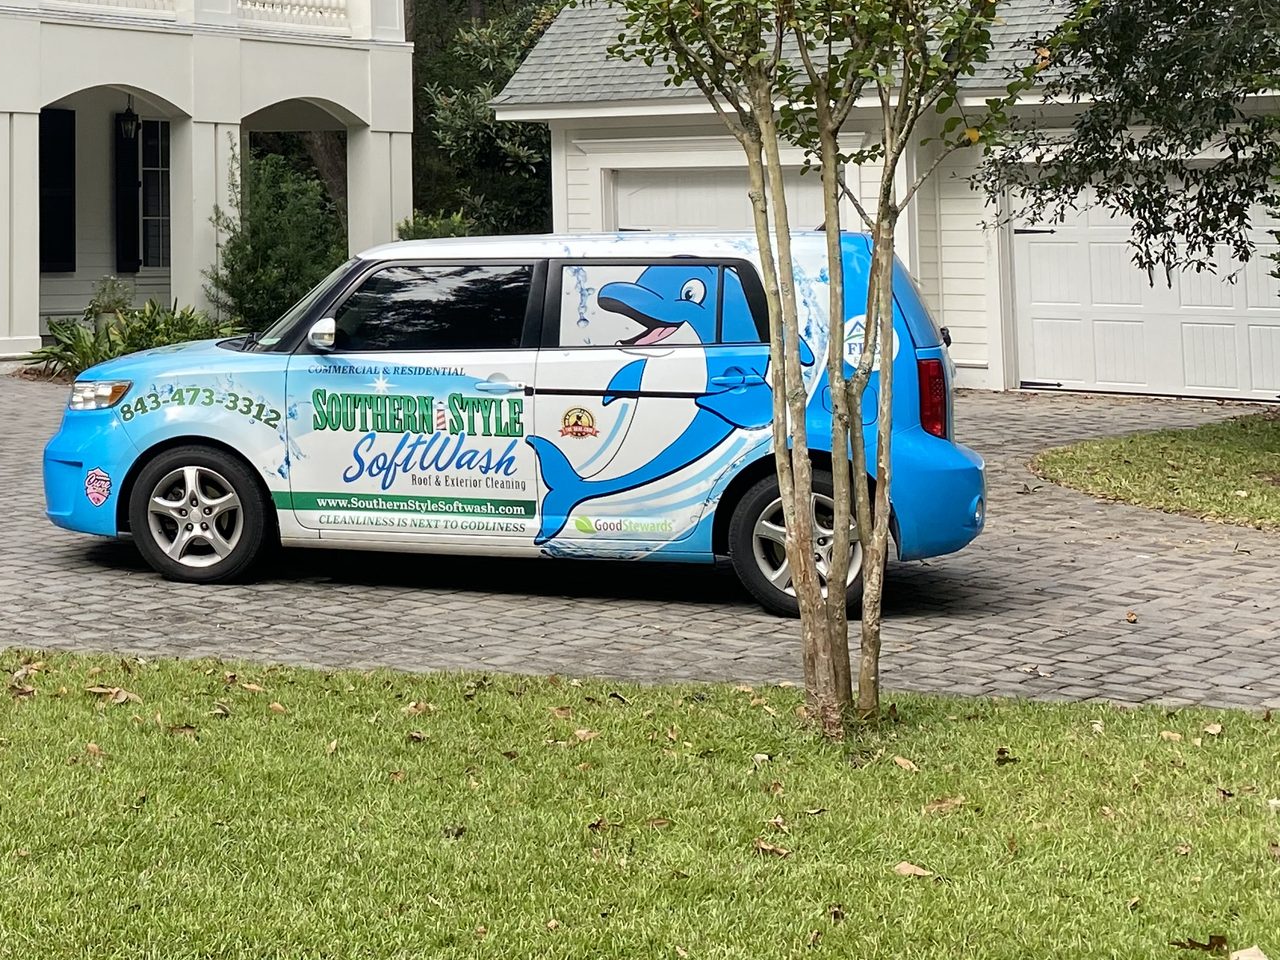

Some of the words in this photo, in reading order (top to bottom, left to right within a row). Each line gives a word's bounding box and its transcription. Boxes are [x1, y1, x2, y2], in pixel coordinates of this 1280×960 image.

[308, 365, 380, 375] COMMERCIAL
[382, 366, 391, 375] &
[393, 366, 466, 376] RESIDENTIAL
[120, 387, 282, 429] 843-473-3312
[312, 389, 434, 434] SOUTHERN
[448, 393, 524, 437] STYLE
[411, 474, 432, 486] Roof
[434, 475, 441, 486] &
[444, 475, 482, 488] Exterior
[485, 477, 526, 491] Cleaning
[316, 497, 526, 515] www.SouthernStyleSoftwash.com
[318, 515, 395, 527] CLEANLINESS
[397, 518, 407, 528] IS
[410, 519, 441, 529] NEXT
[442, 520, 458, 530] TO
[460, 521, 526, 533] GODLINESS
